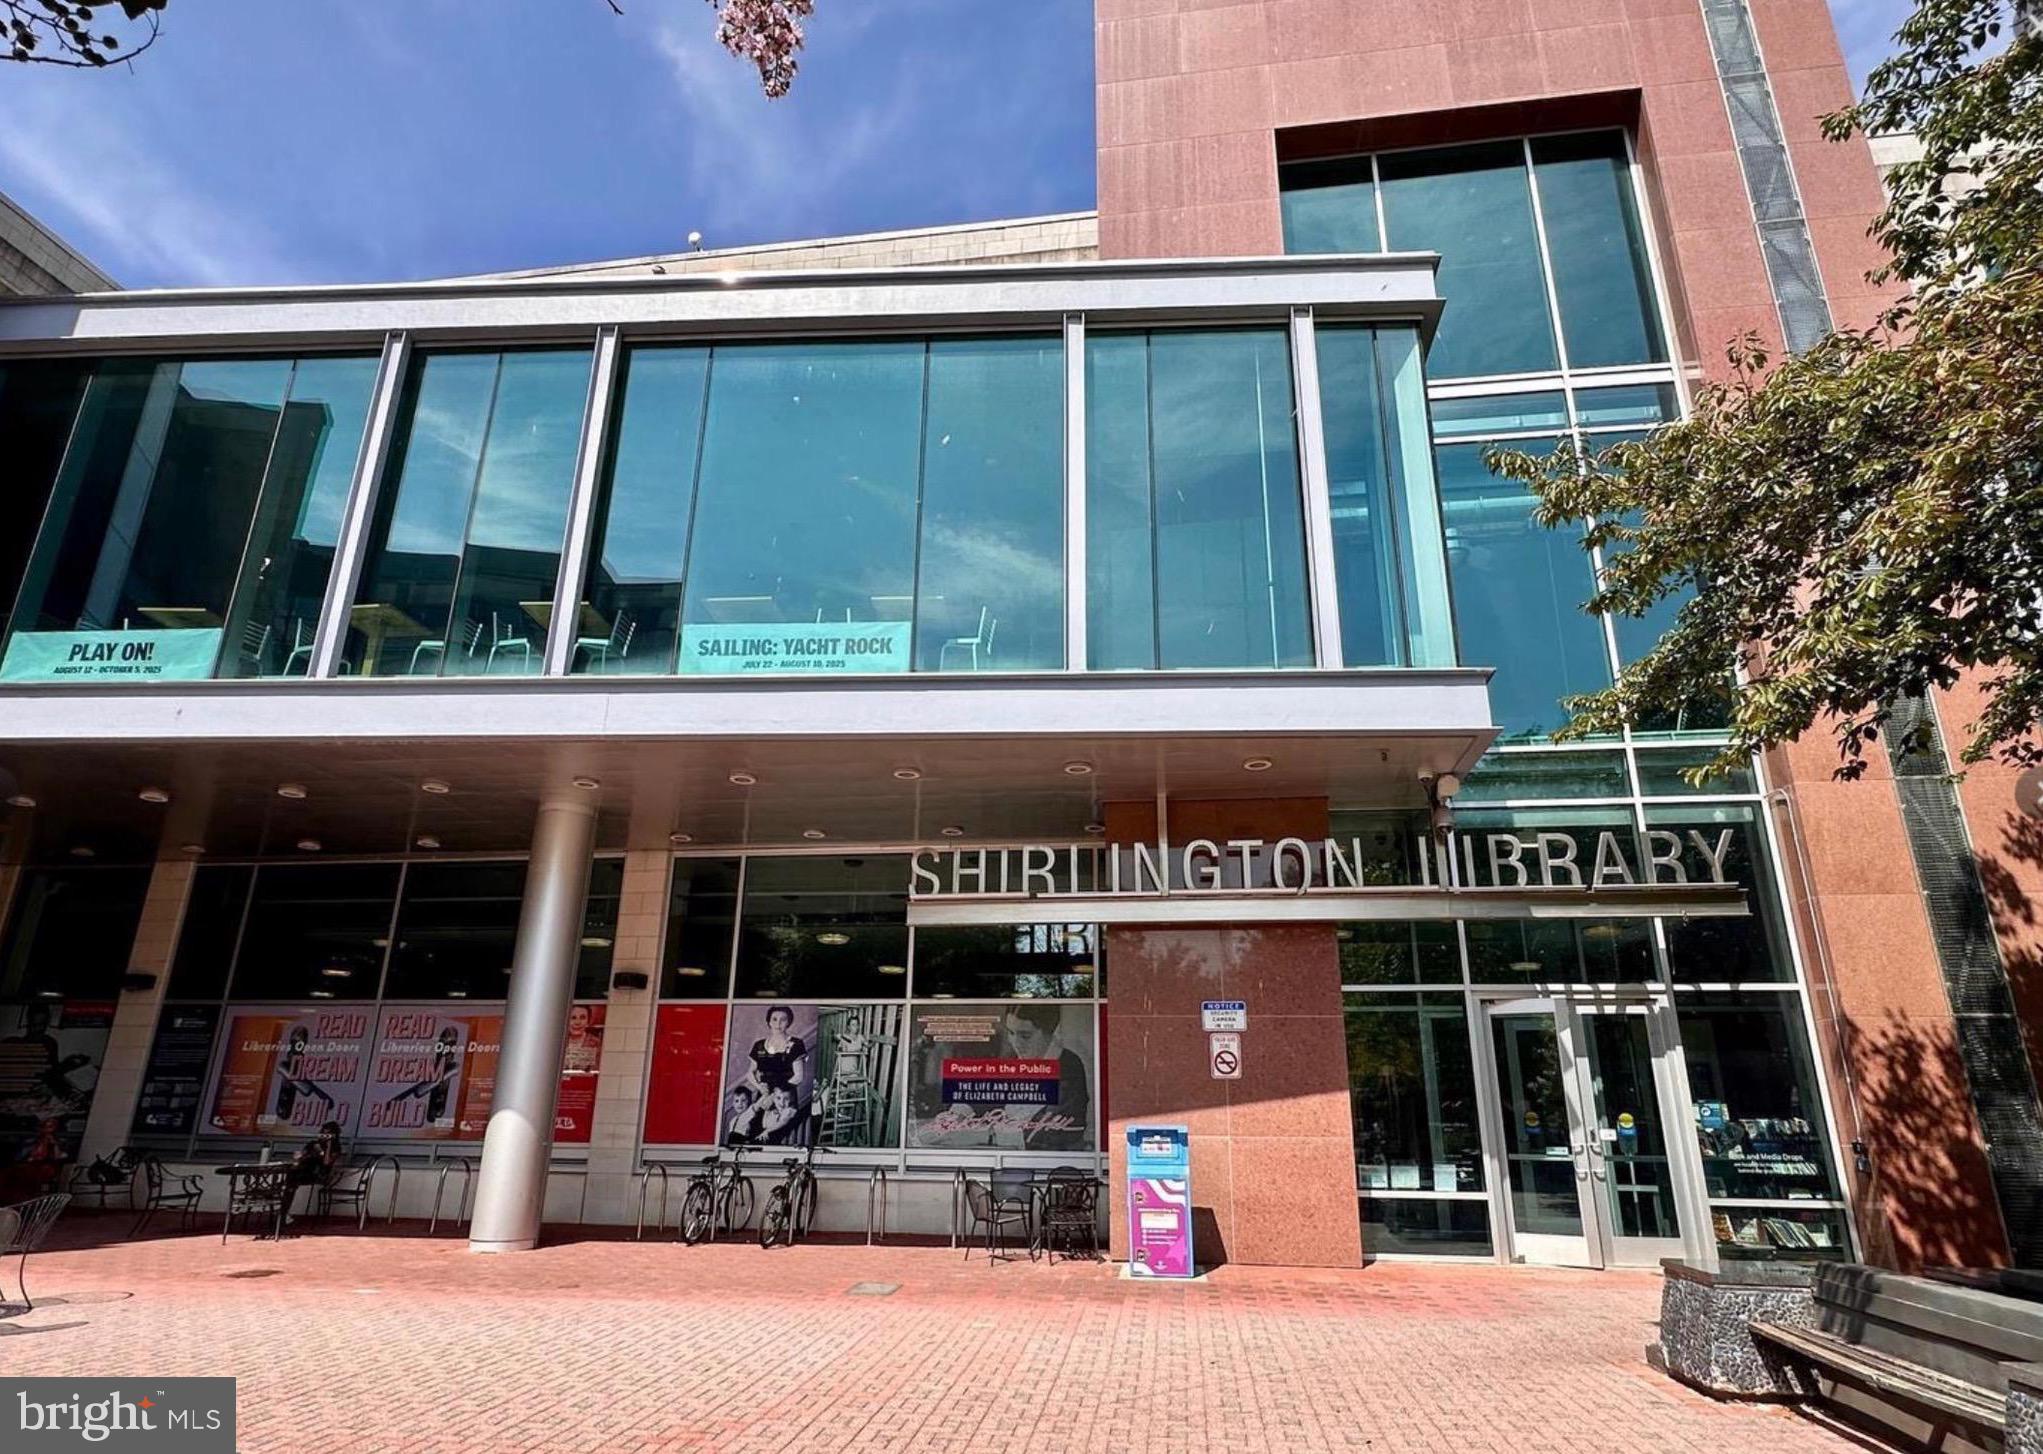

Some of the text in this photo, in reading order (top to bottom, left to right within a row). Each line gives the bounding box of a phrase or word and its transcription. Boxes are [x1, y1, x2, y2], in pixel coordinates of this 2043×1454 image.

[68, 642, 155, 661] PLAY ON!
[698, 637, 892, 656] SAILING: YACHT ROCK
[53, 666, 83, 674] AUGUST
[99, 666, 133, 674] OCTOBER
[742, 660, 761, 668] JULY
[762, 660, 773, 668] 22
[780, 660, 811, 668] AUGUST
[825, 660, 846, 668] 2025
[910, 828, 1734, 896] SHIRLINGTON LIBRARY
[314, 1014, 367, 1039] READ
[384, 1015, 437, 1040] READ
[242, 1041, 359, 1054] Libraries Open Doors
[380, 1042, 432, 1053] Libraries
[434, 1042, 464, 1054] Open
[289, 1055, 359, 1082] DREAM
[377, 1057, 446, 1083] DREAM
[950, 1063, 983, 1074] Power
[999, 1063, 1017, 1074] the
[1019, 1063, 1052, 1074] Public
[952, 1091, 1047, 1102] OF ELIZABETH CAMPBELL
[959, 1082, 1040, 1092] THE LIFE AND LEGACY
[367, 1101, 428, 1128] BUILD
